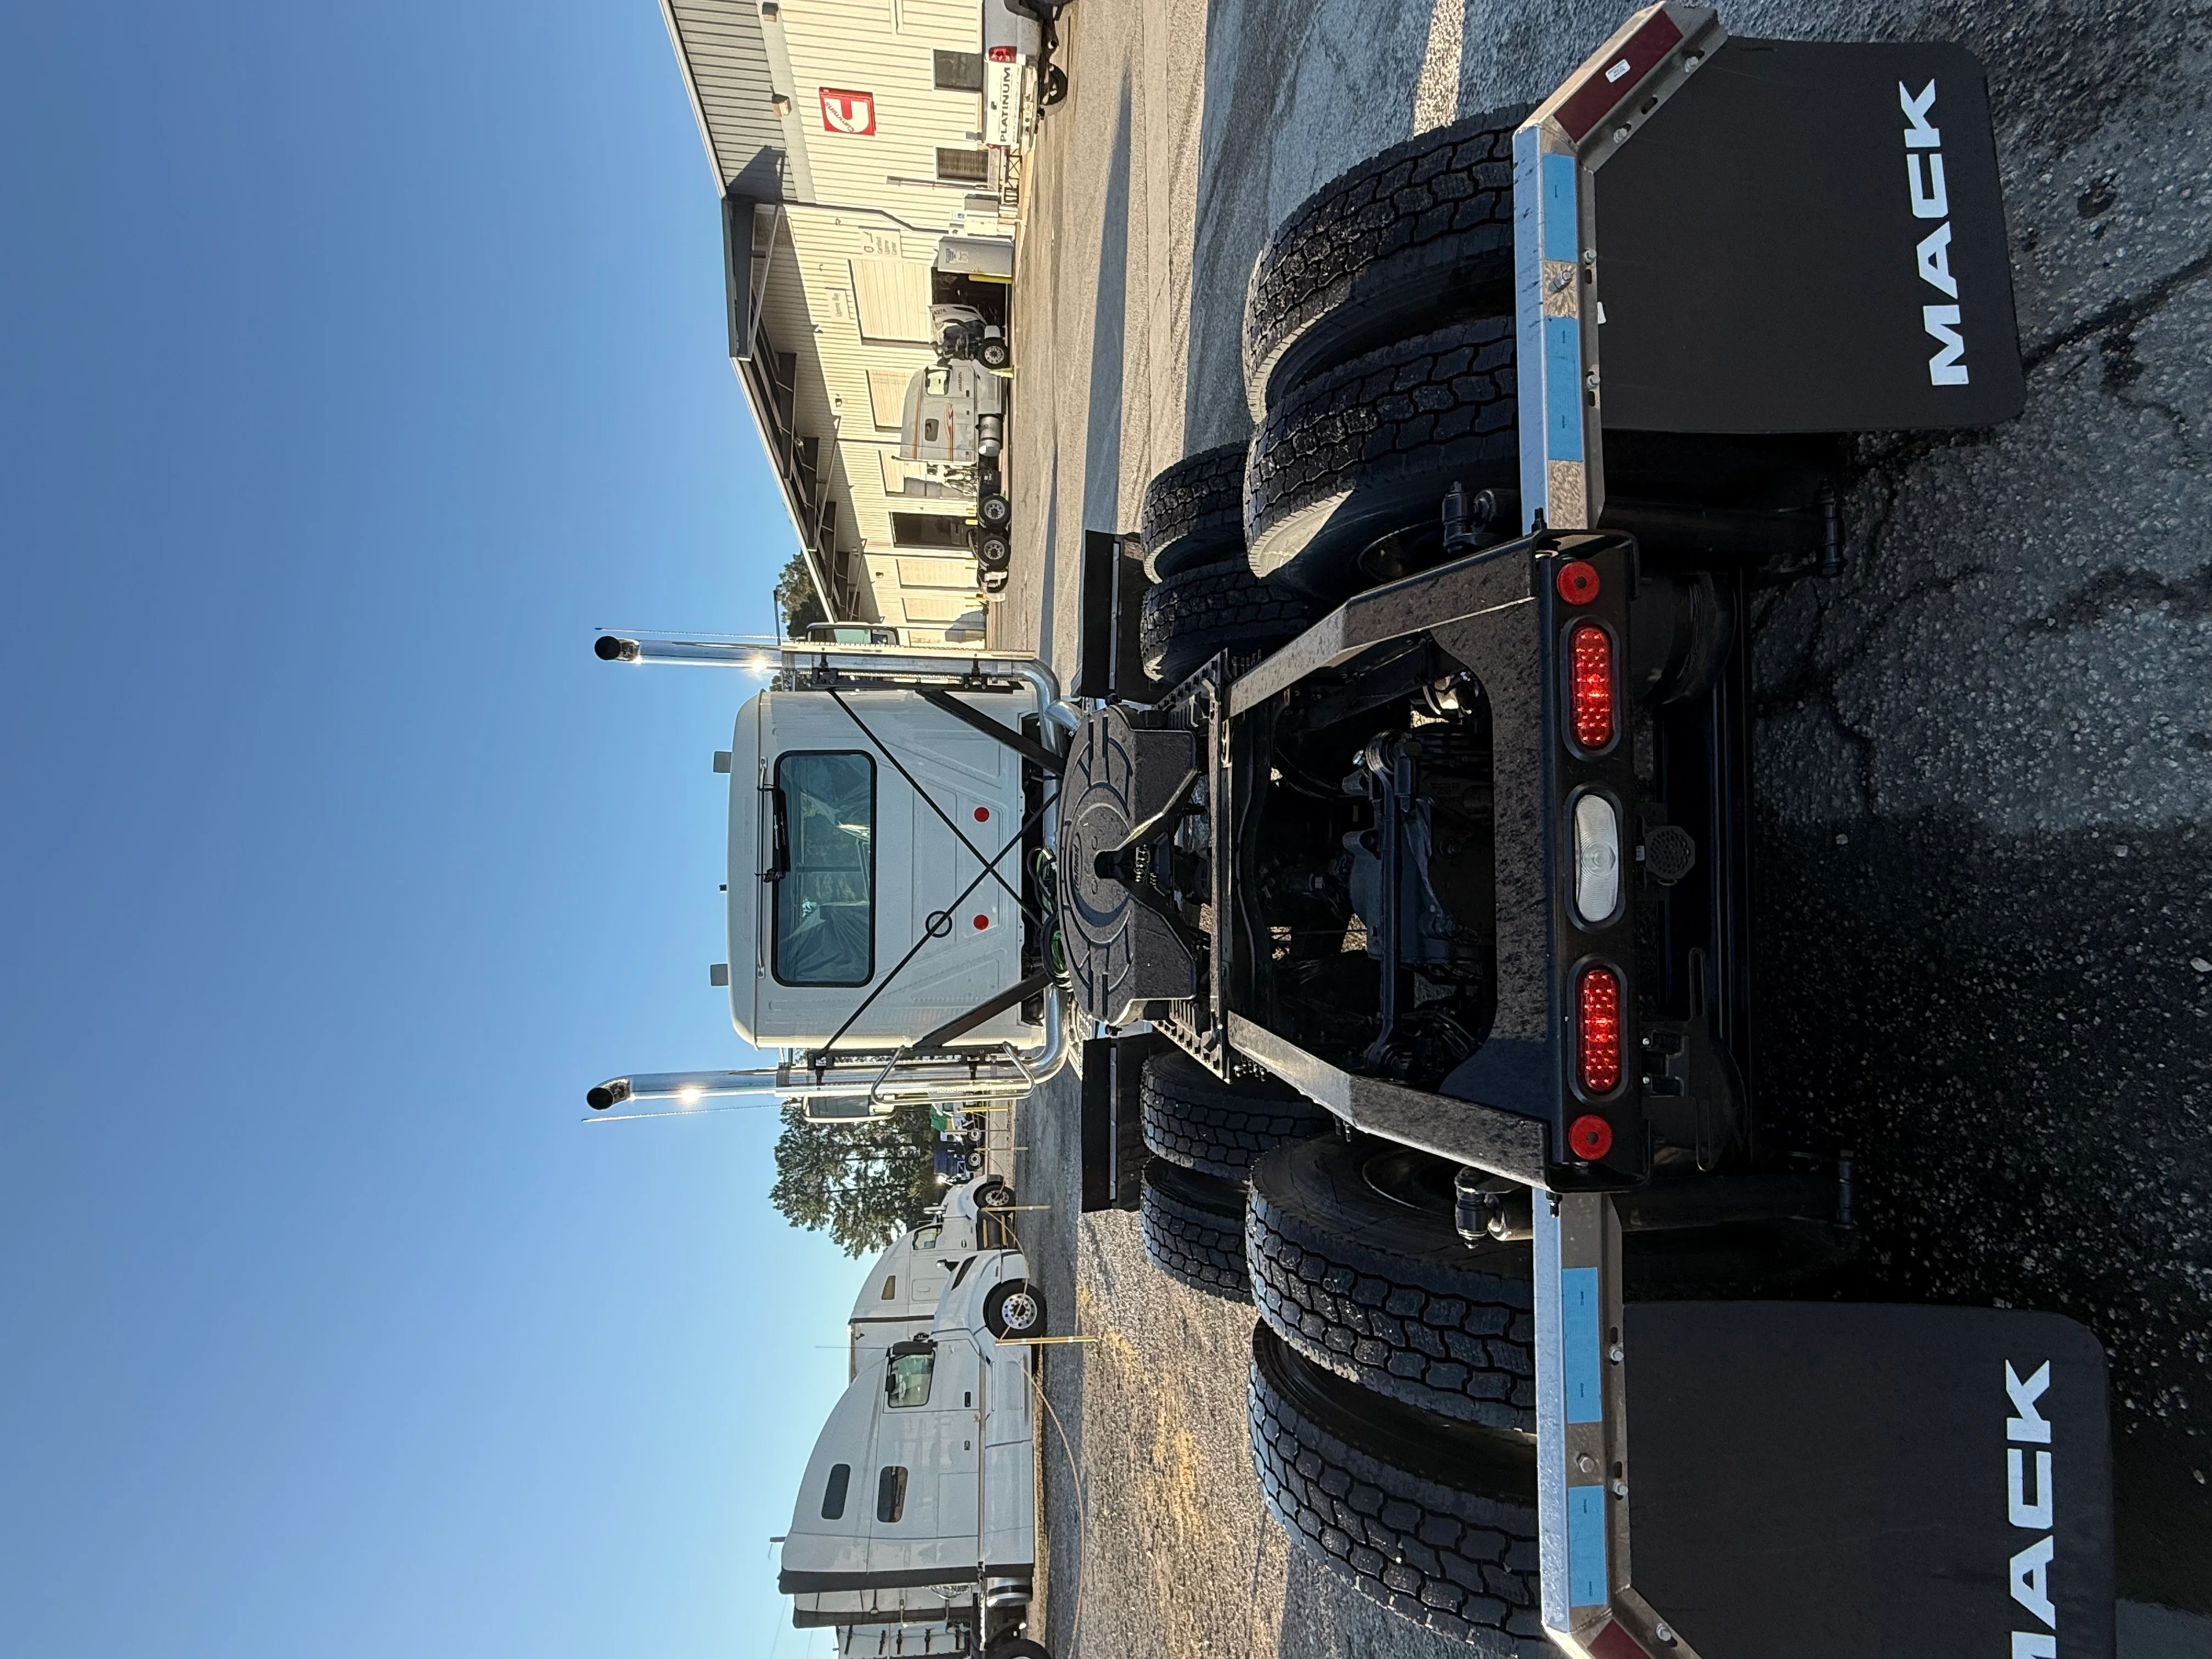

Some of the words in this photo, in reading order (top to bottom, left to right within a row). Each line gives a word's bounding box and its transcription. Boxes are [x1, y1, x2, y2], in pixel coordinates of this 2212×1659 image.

[825, 101, 854, 133] Cummins
[1000, 67, 1011, 142] PLATINUM
[1899, 79, 1969, 385] MACK
[832, 293, 840, 301] Bay
